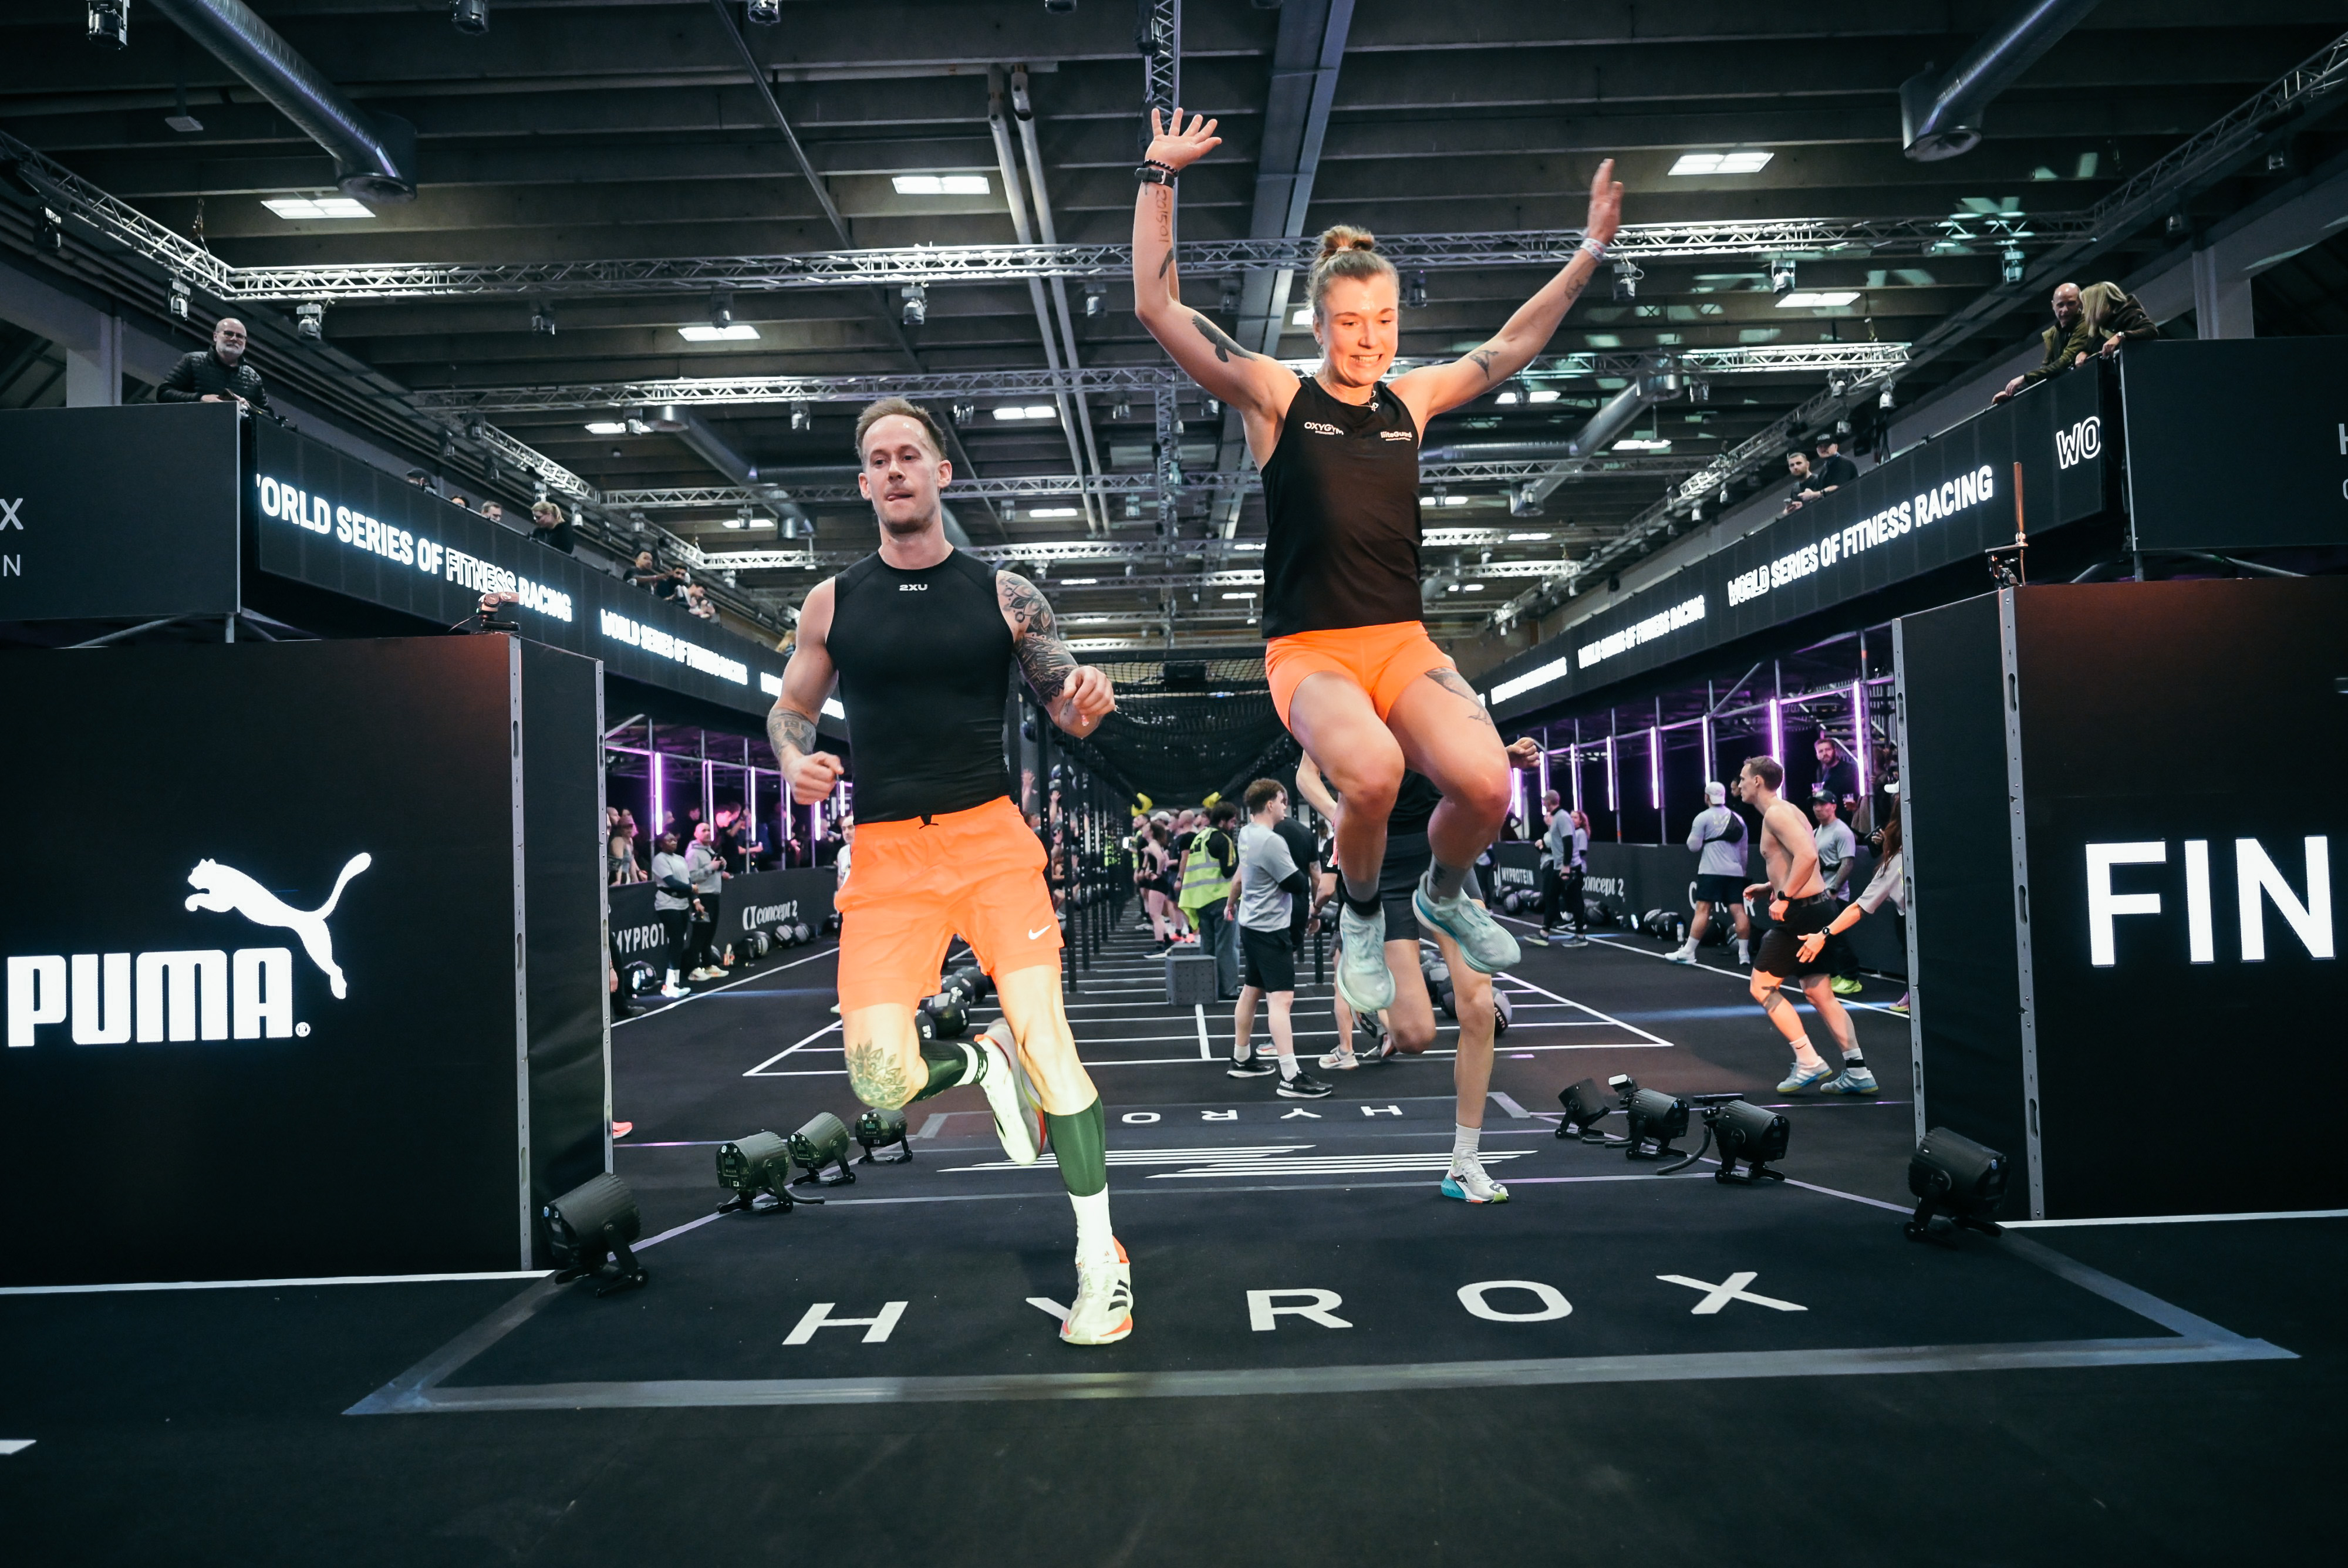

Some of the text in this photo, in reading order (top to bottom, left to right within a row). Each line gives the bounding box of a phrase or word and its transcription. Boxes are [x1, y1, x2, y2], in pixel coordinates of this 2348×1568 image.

[1156, 189, 1170, 242] 201501
[1304, 421, 1344, 436] OXYGYM
[256, 473, 572, 622] ORLD SERIES OF FITNESS RACING
[1728, 465, 1993, 606] WORLD SERIES OF FITNESS RACING
[1502, 867, 1534, 886] MYPROTEIN
[1618, 878, 1624, 897] 2
[756, 900, 798, 924] concept 2
[2085, 835, 2336, 967] FIN
[611, 923, 670, 954] MYPROT
[8, 947, 293, 1047] PUMA
[1122, 1105, 1402, 1124] HYRO
